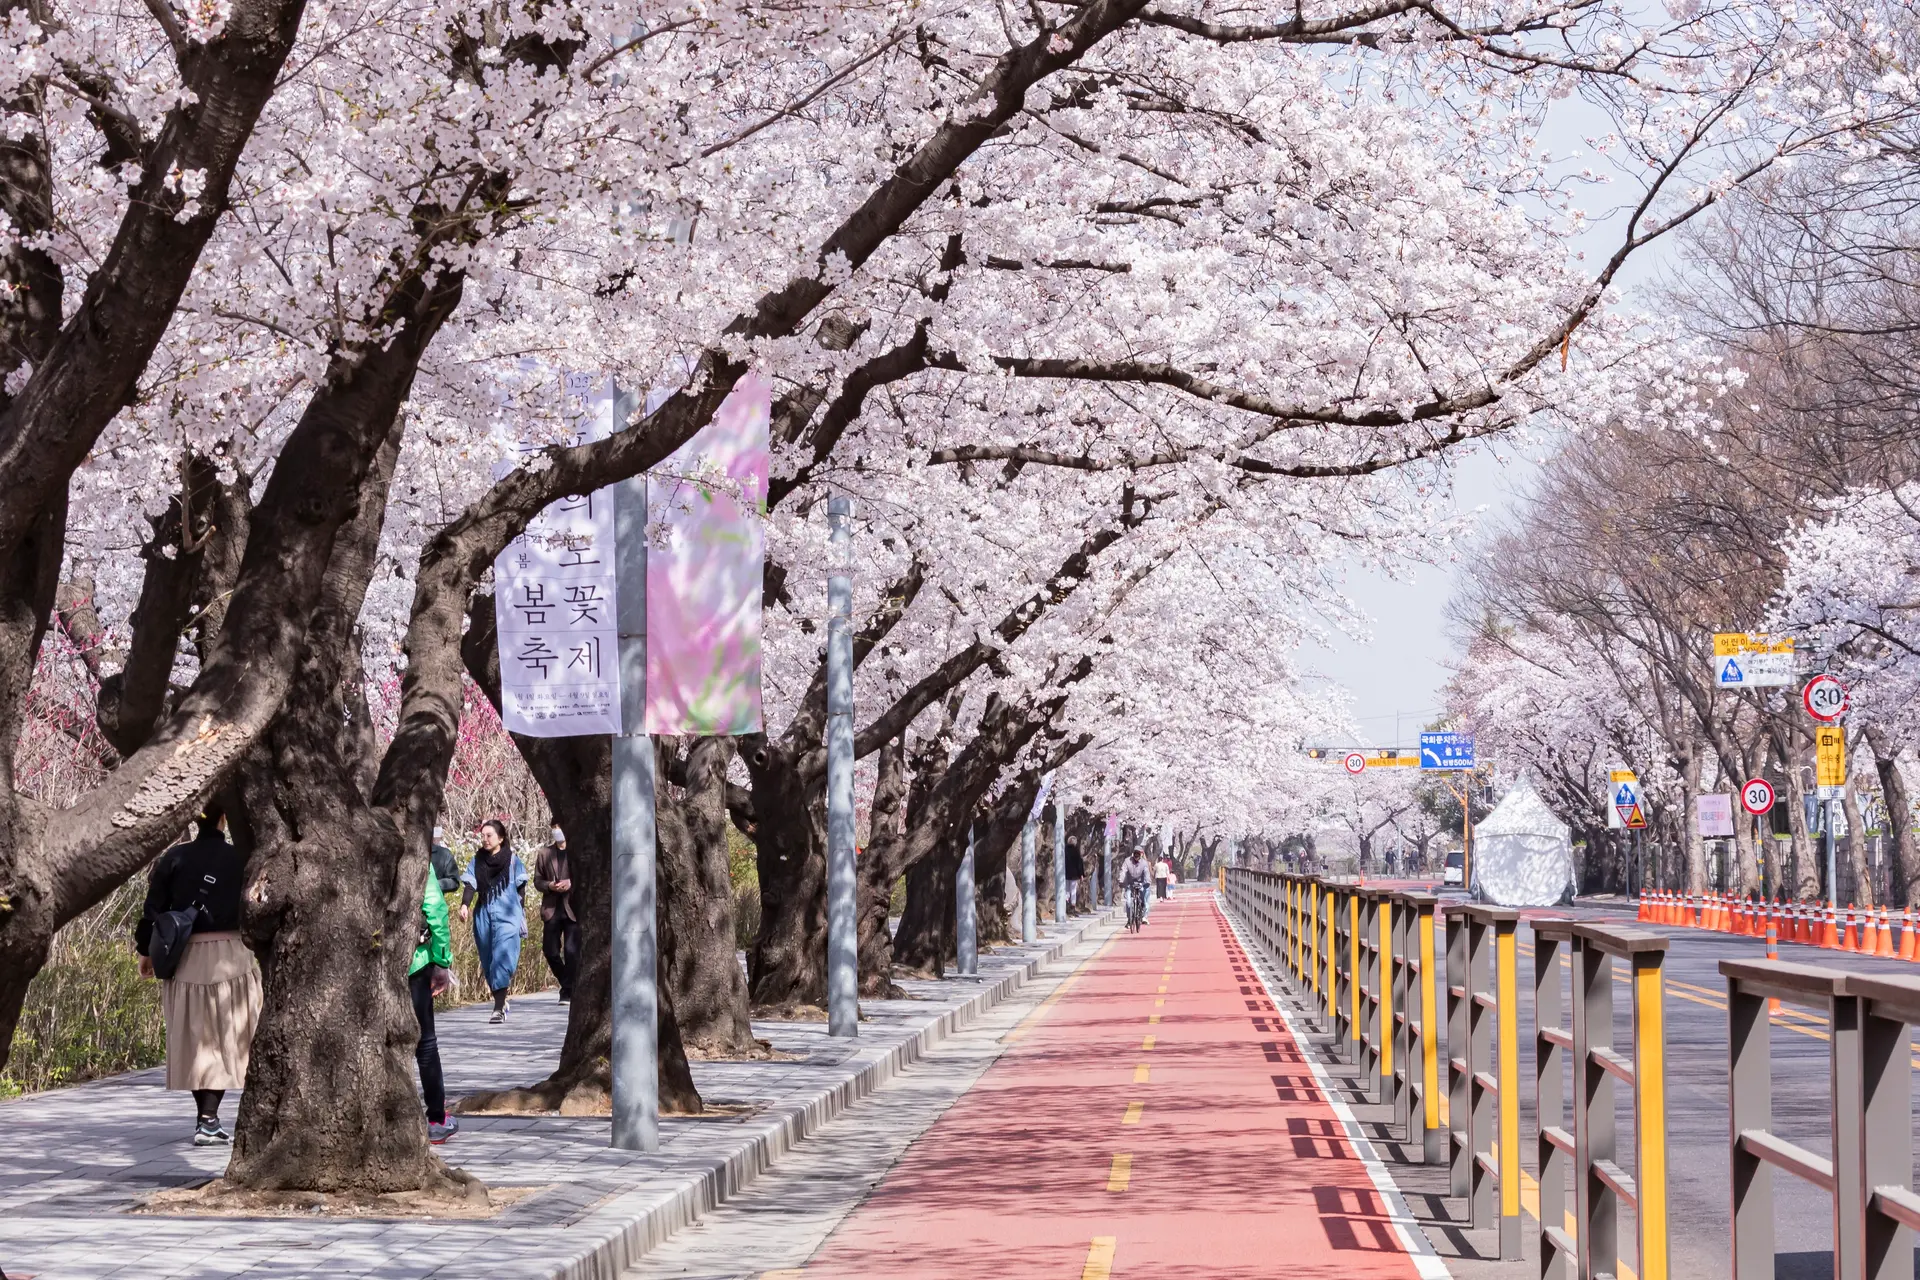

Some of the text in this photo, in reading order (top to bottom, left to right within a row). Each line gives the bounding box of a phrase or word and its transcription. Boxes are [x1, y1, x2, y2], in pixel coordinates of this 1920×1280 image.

[1814, 688, 1841, 708] 30
[1349, 758, 1362, 768] 30
[1749, 789, 1767, 804] 30
